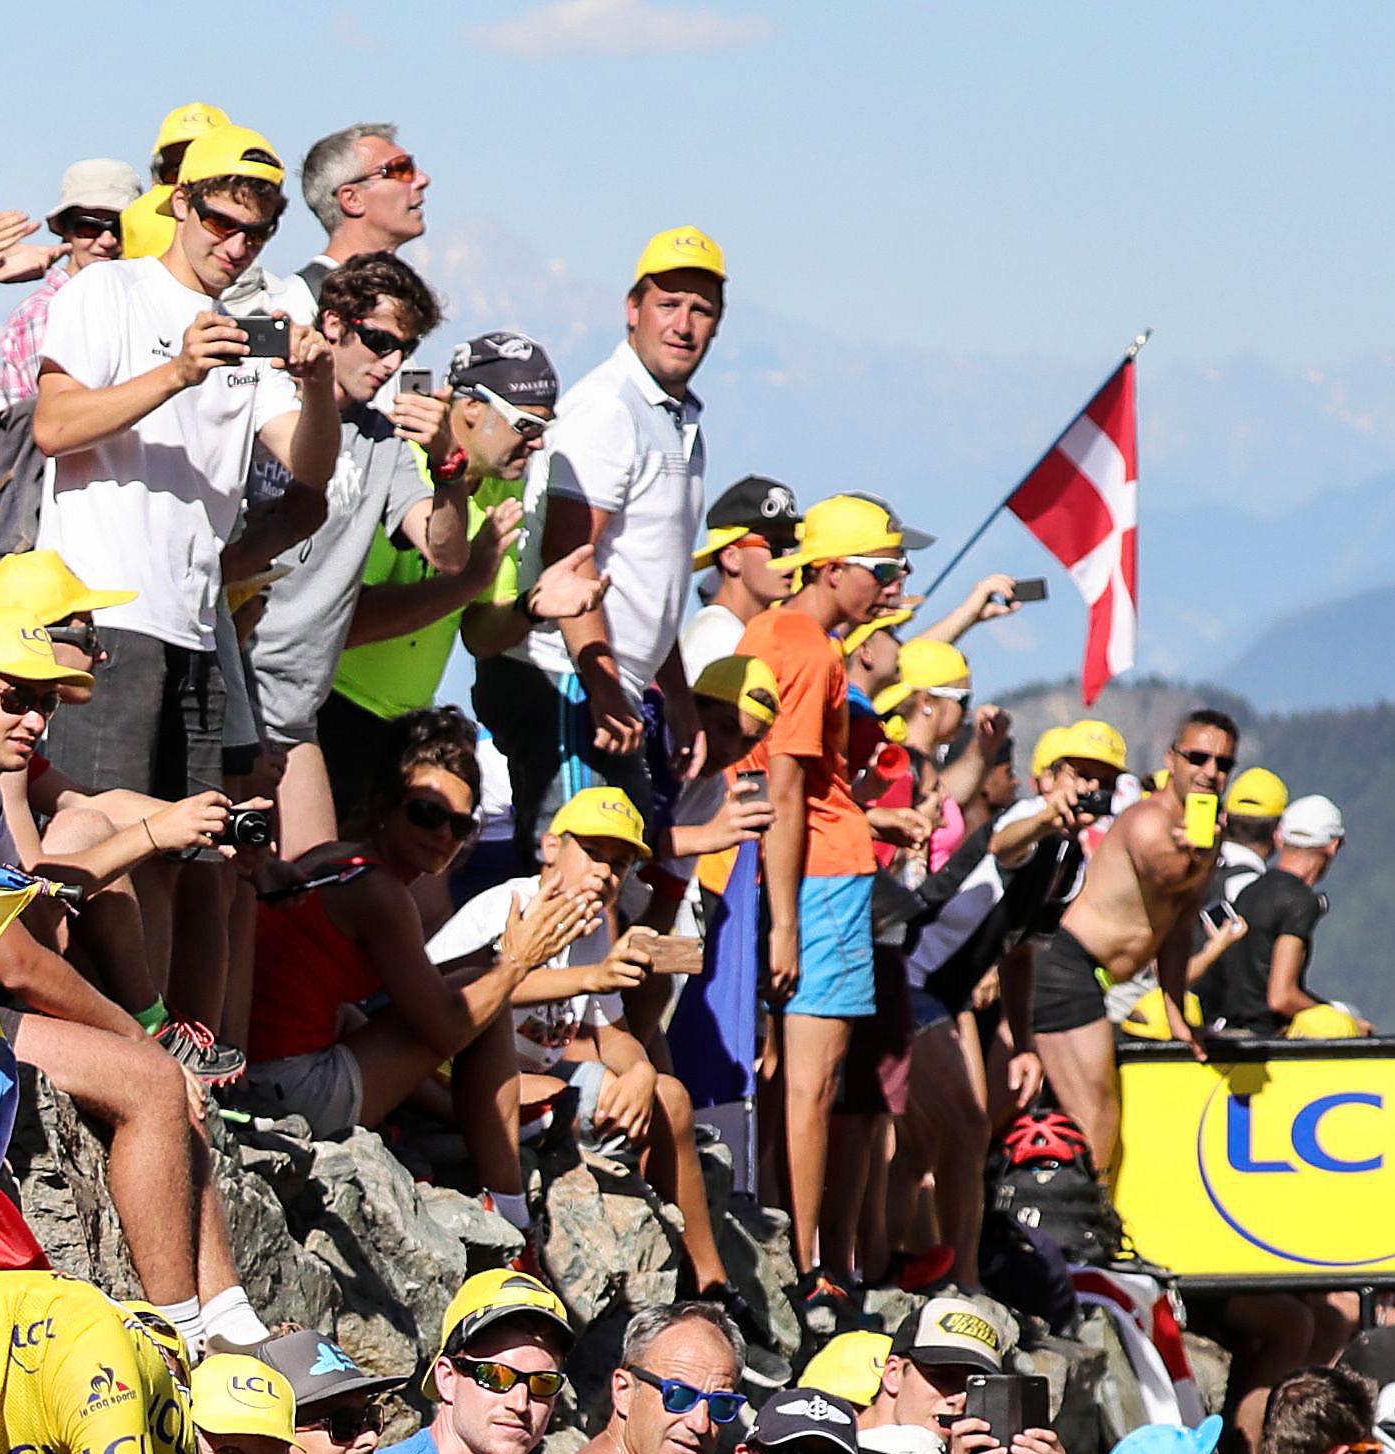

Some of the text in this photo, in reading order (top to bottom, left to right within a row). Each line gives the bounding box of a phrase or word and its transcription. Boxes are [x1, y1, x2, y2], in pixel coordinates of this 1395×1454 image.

[21, 628, 47, 642] LC
[1227, 1092, 1383, 1174] LC
[12, 1317, 56, 1349] LCL
[233, 1376, 281, 1400] LCL
